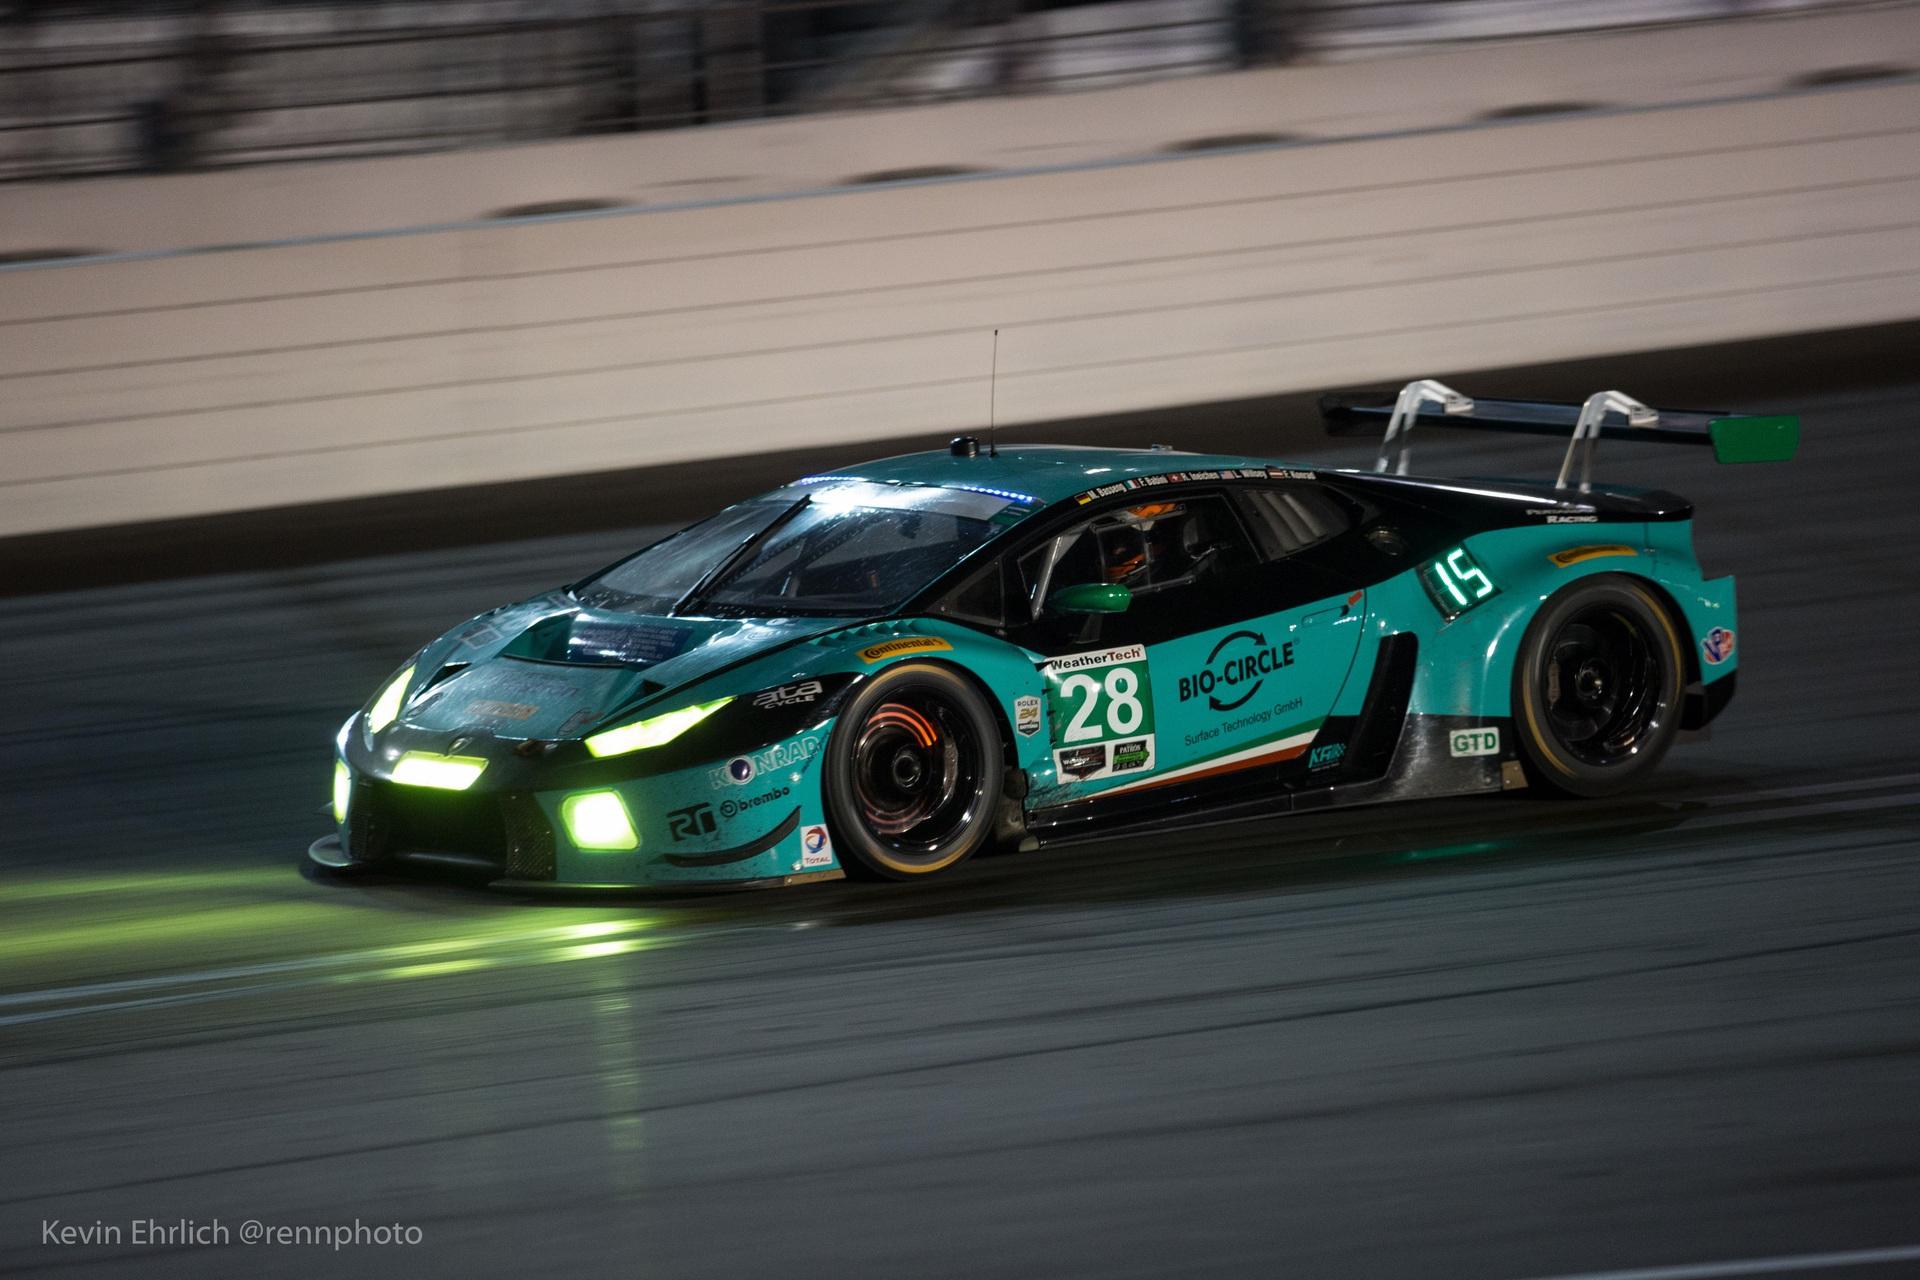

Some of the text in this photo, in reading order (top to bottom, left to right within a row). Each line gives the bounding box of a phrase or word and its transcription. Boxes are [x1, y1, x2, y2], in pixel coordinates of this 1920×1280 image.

[1435, 547, 1493, 606] 15
[1050, 649, 1140, 670] WeatherTech
[1179, 641, 1294, 702] BIO-CIRCLE
[764, 694, 815, 709] CYCLE
[1060, 667, 1144, 743] 28
[1184, 696, 1303, 746] Surface Technology GmbH
[1453, 733, 1497, 752] GTD
[706, 736, 820, 789] KONRAD
[739, 786, 790, 811] brembo
[805, 856, 831, 864] TOTAL
